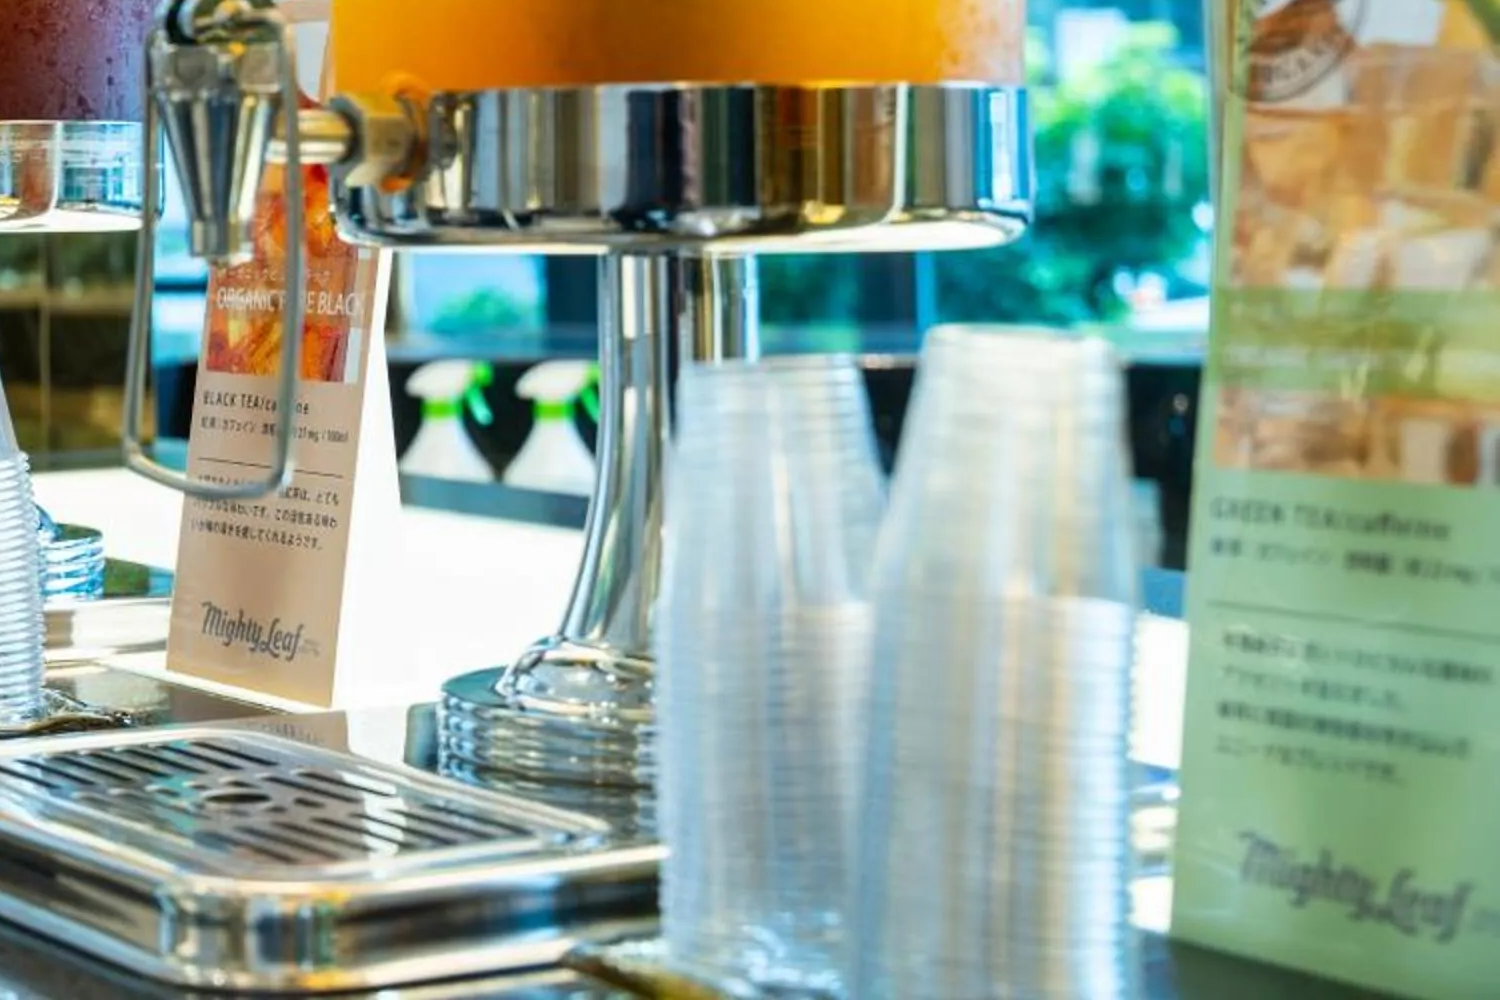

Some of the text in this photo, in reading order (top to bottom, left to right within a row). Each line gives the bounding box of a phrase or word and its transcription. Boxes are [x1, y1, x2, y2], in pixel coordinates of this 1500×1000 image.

[216, 286, 275, 312] ORGANIC
[203, 390, 237, 407] BLACK
[201, 601, 262, 652] Mighty
[261, 617, 304, 662] Leaf
